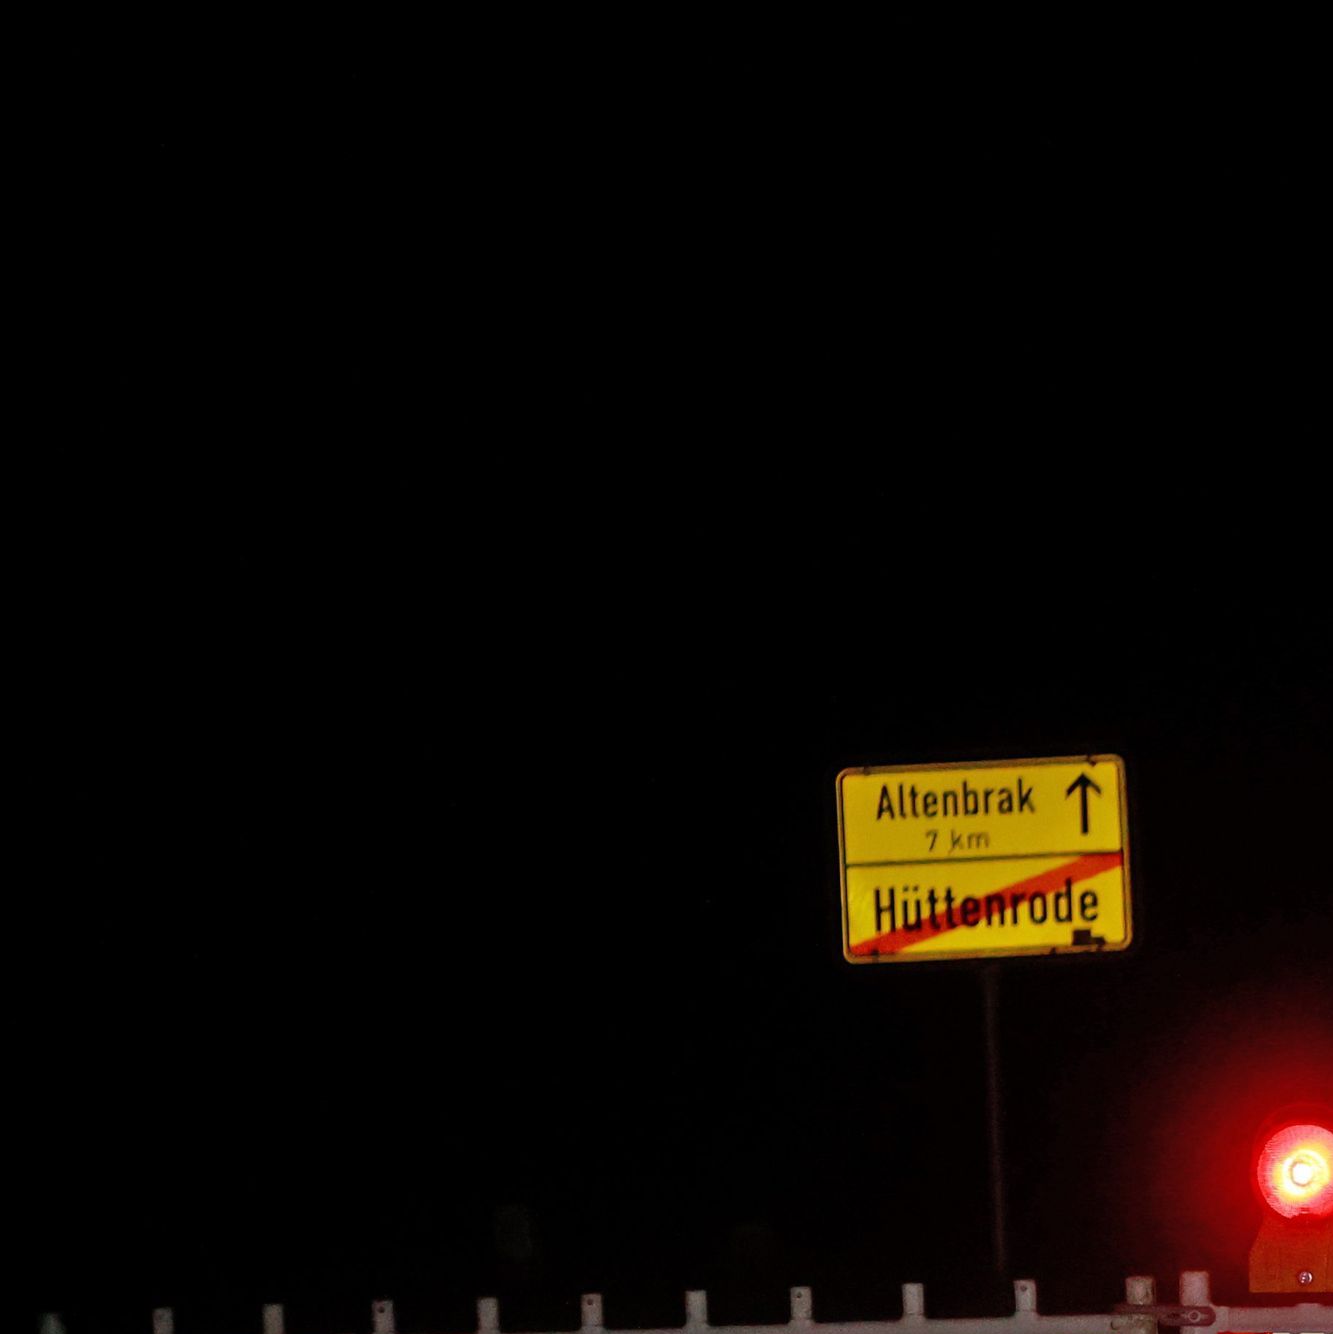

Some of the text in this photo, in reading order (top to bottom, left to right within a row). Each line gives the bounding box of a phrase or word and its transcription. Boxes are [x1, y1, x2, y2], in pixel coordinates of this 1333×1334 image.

[876, 776, 1036, 821] Altenbrak
[924, 829, 990, 852] 7 km
[874, 878, 1099, 933] Hüttenrode
